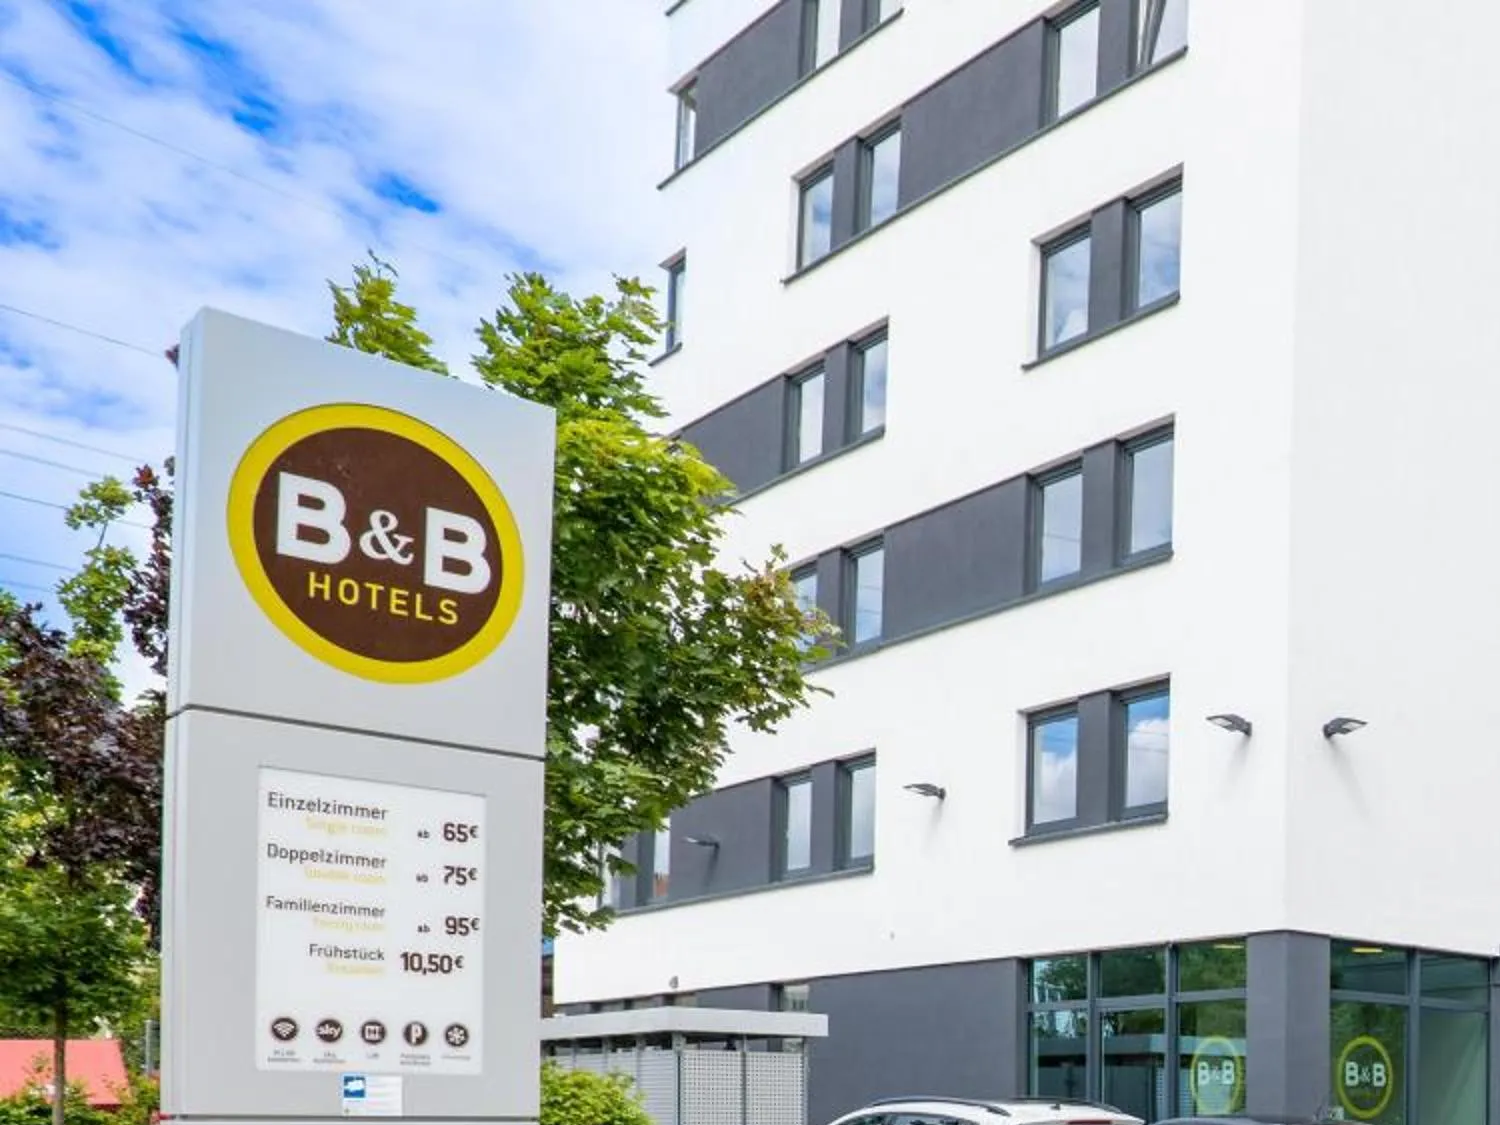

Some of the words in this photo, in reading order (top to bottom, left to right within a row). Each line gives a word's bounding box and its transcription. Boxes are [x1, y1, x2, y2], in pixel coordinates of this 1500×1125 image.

[276, 472, 491, 594] B&B
[309, 571, 459, 626] HOTELS
[266, 791, 389, 822] Einzelzimmer
[443, 822, 479, 843] 65€
[266, 843, 388, 870] Doppelzimmer
[442, 865, 478, 887] 75€
[265, 895, 386, 919] Familienzimmer
[444, 916, 480, 936] 95€
[308, 943, 385, 962] Frühstück
[1197, 1060, 1235, 1085] B&B
[1344, 1061, 1386, 1087] B&B
